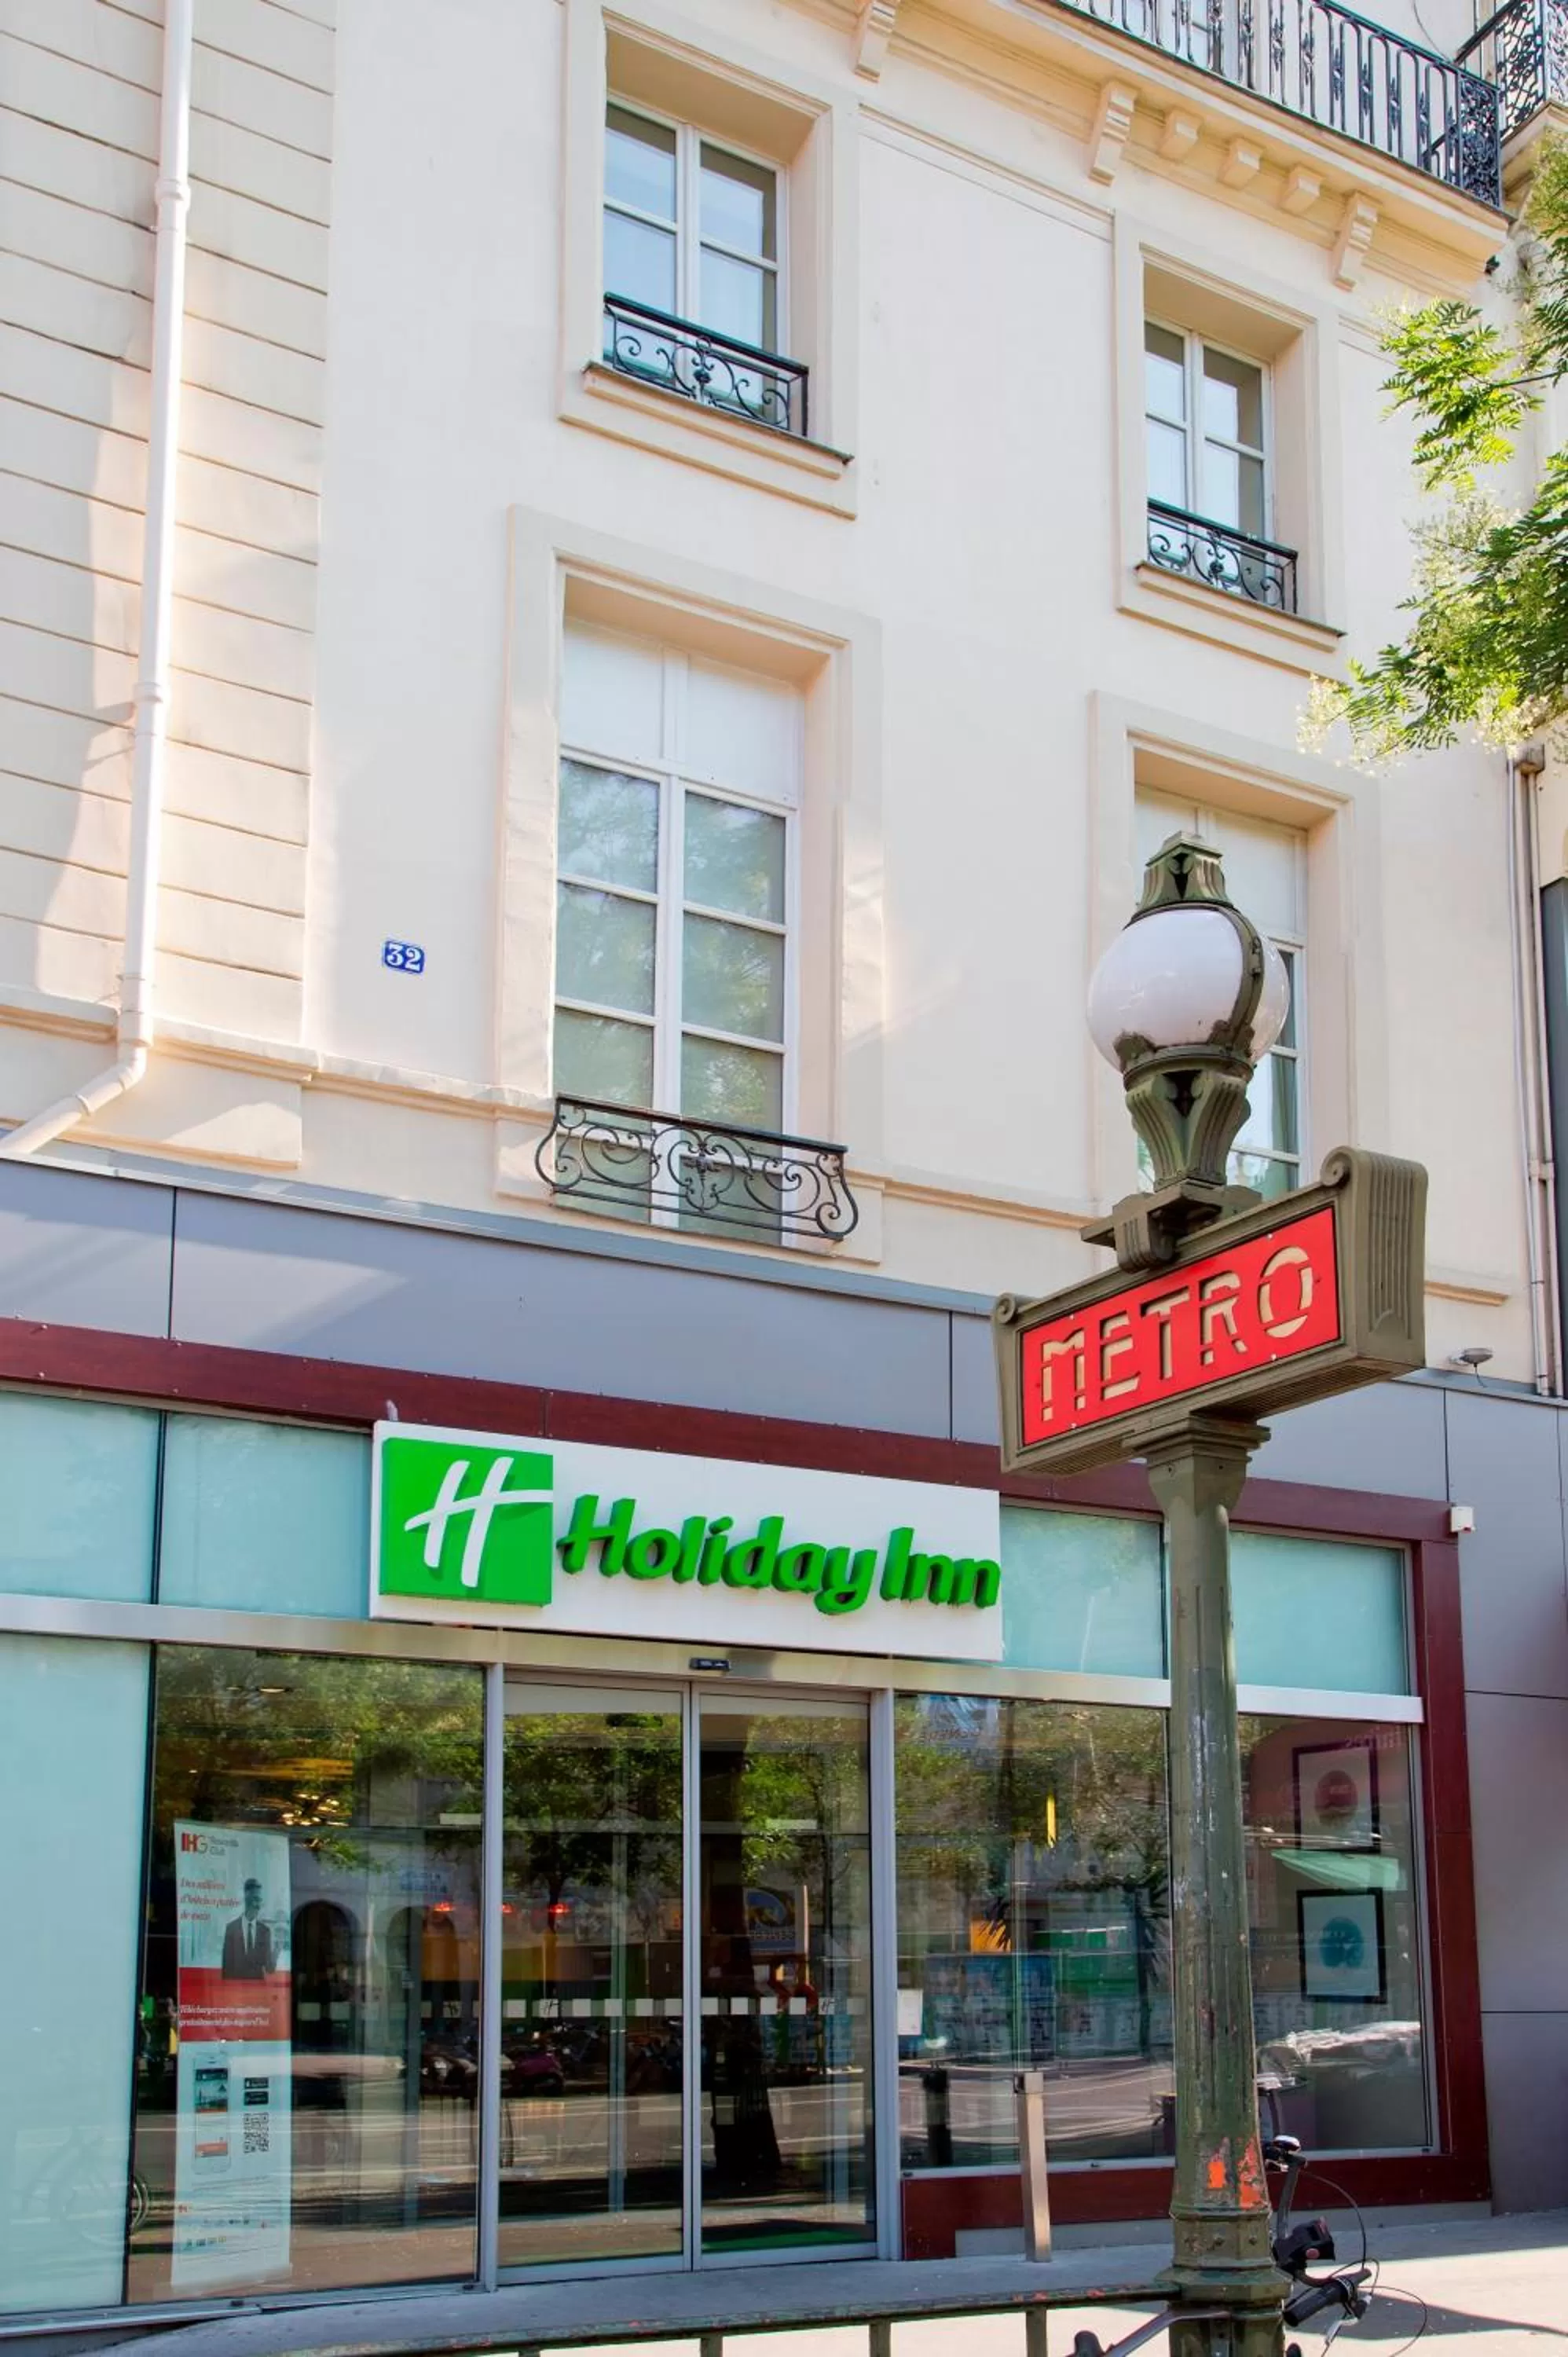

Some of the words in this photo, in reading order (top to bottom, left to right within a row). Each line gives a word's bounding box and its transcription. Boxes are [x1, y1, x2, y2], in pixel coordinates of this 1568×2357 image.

[387, 943, 422, 972] 32
[1040, 1245, 1314, 1422] METRO
[556, 1494, 877, 1615] Holiday
[879, 1527, 1002, 1609] Inn
[181, 1832, 207, 1853] IHG
